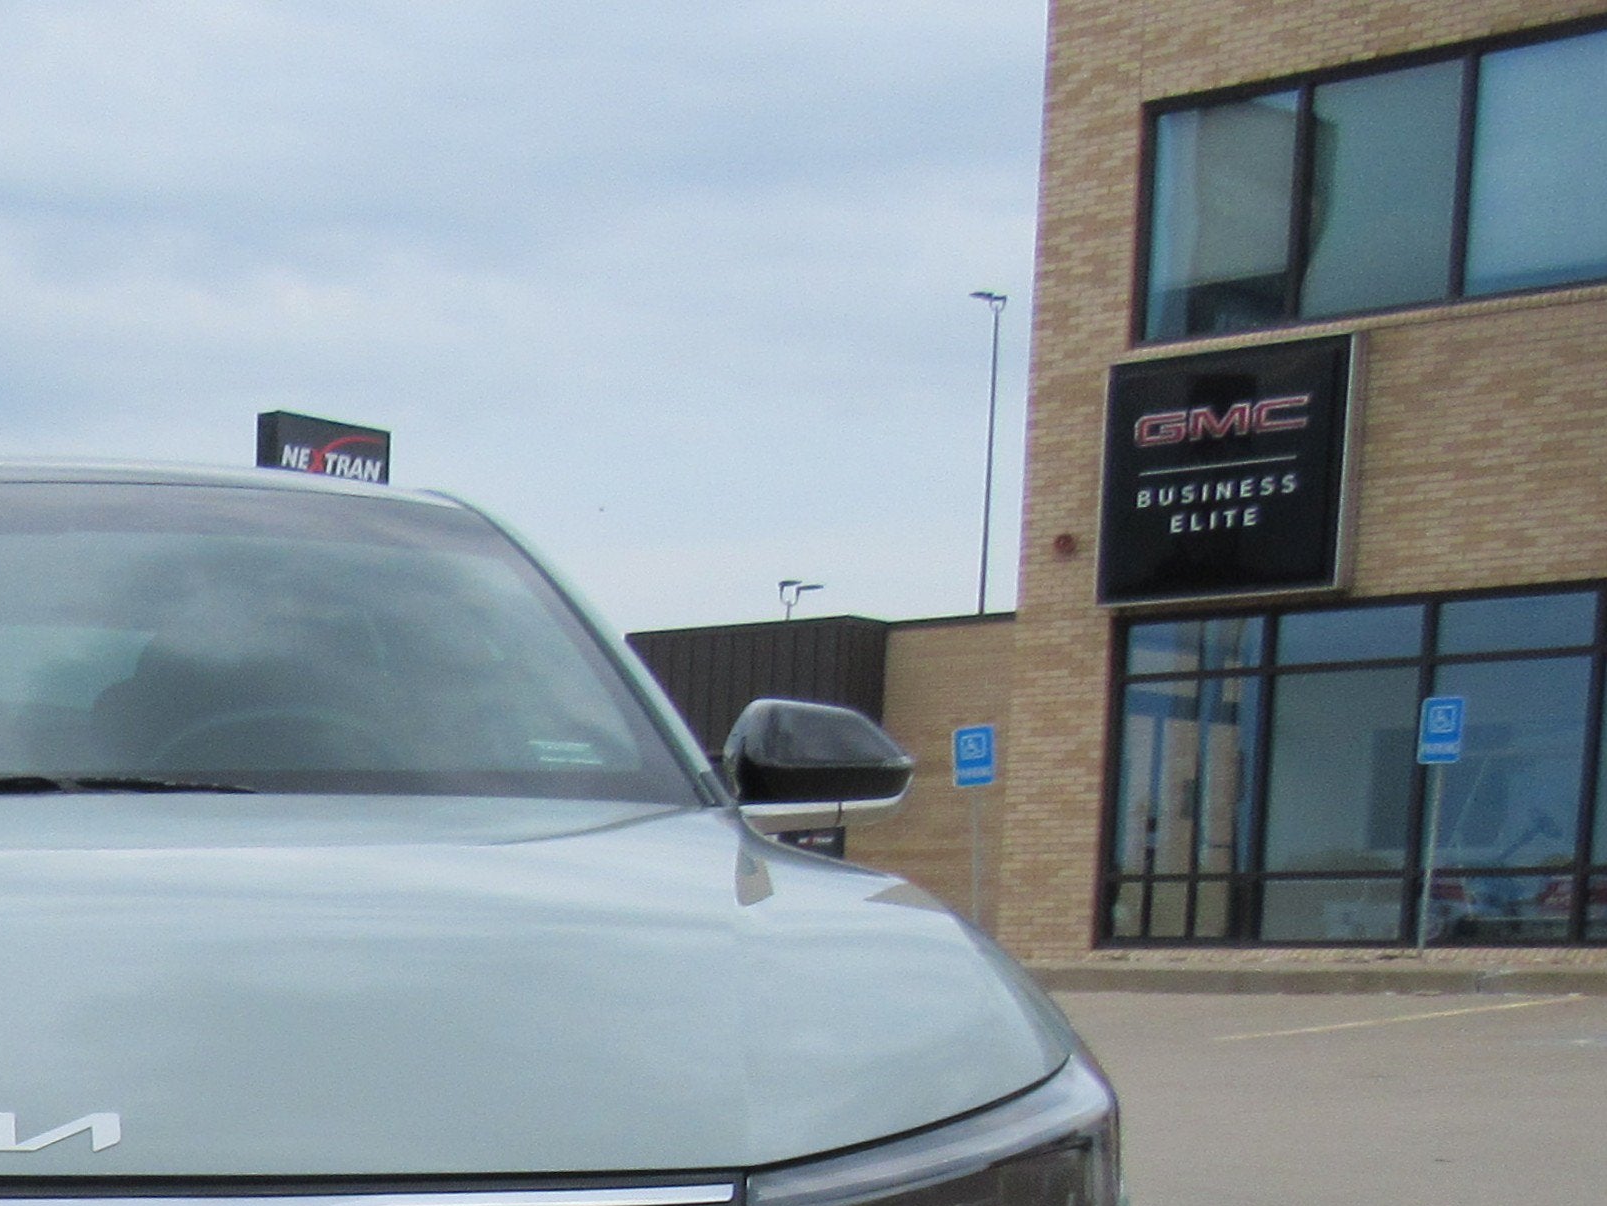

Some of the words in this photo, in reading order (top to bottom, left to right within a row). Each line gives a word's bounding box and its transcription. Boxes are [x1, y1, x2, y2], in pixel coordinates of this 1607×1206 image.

[1134, 395, 1309, 447] GMC
[281, 444, 382, 482] NEXTRAN
[1136, 473, 1297, 509] BUSINESS
[1170, 507, 1259, 534] ELITE
